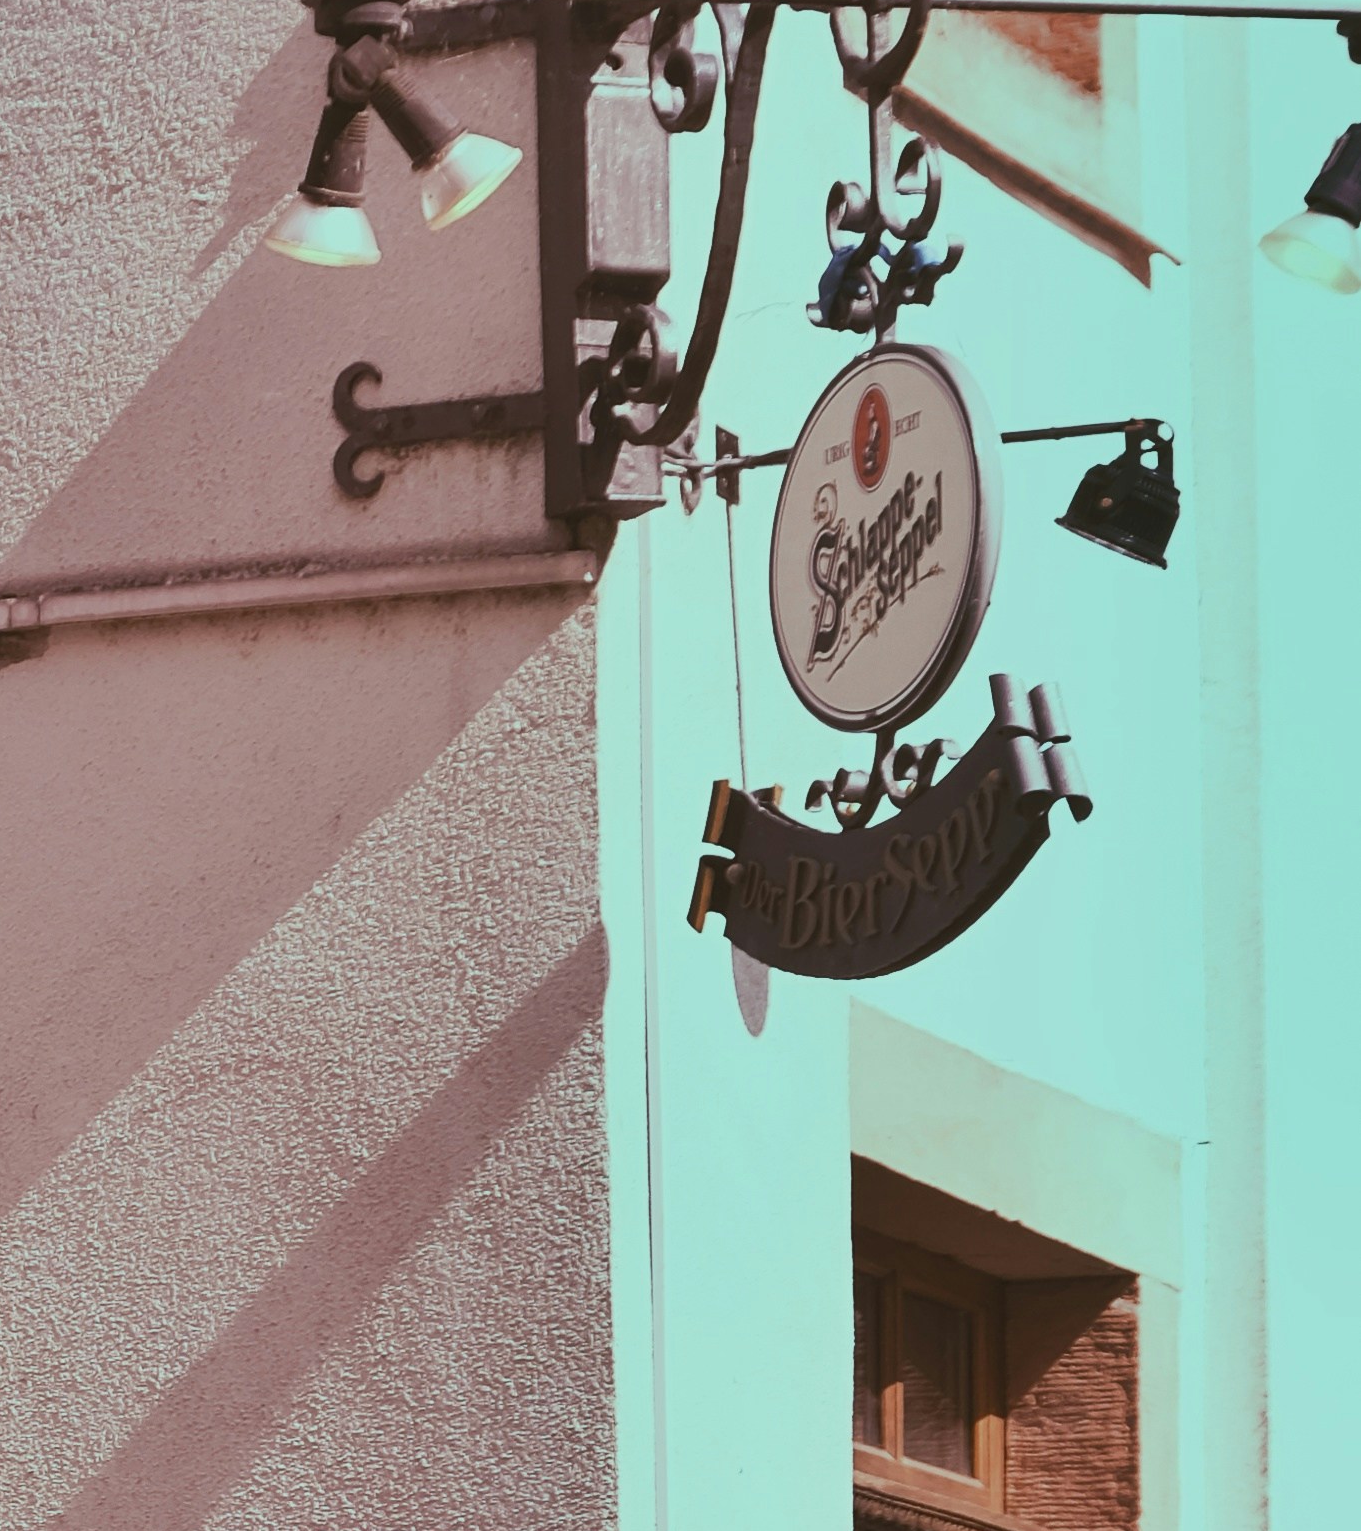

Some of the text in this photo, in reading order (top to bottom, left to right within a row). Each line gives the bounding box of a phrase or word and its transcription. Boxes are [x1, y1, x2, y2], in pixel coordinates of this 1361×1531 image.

[894, 410, 922, 438] ECHT
[740, 787, 998, 950] Der BierSepp
